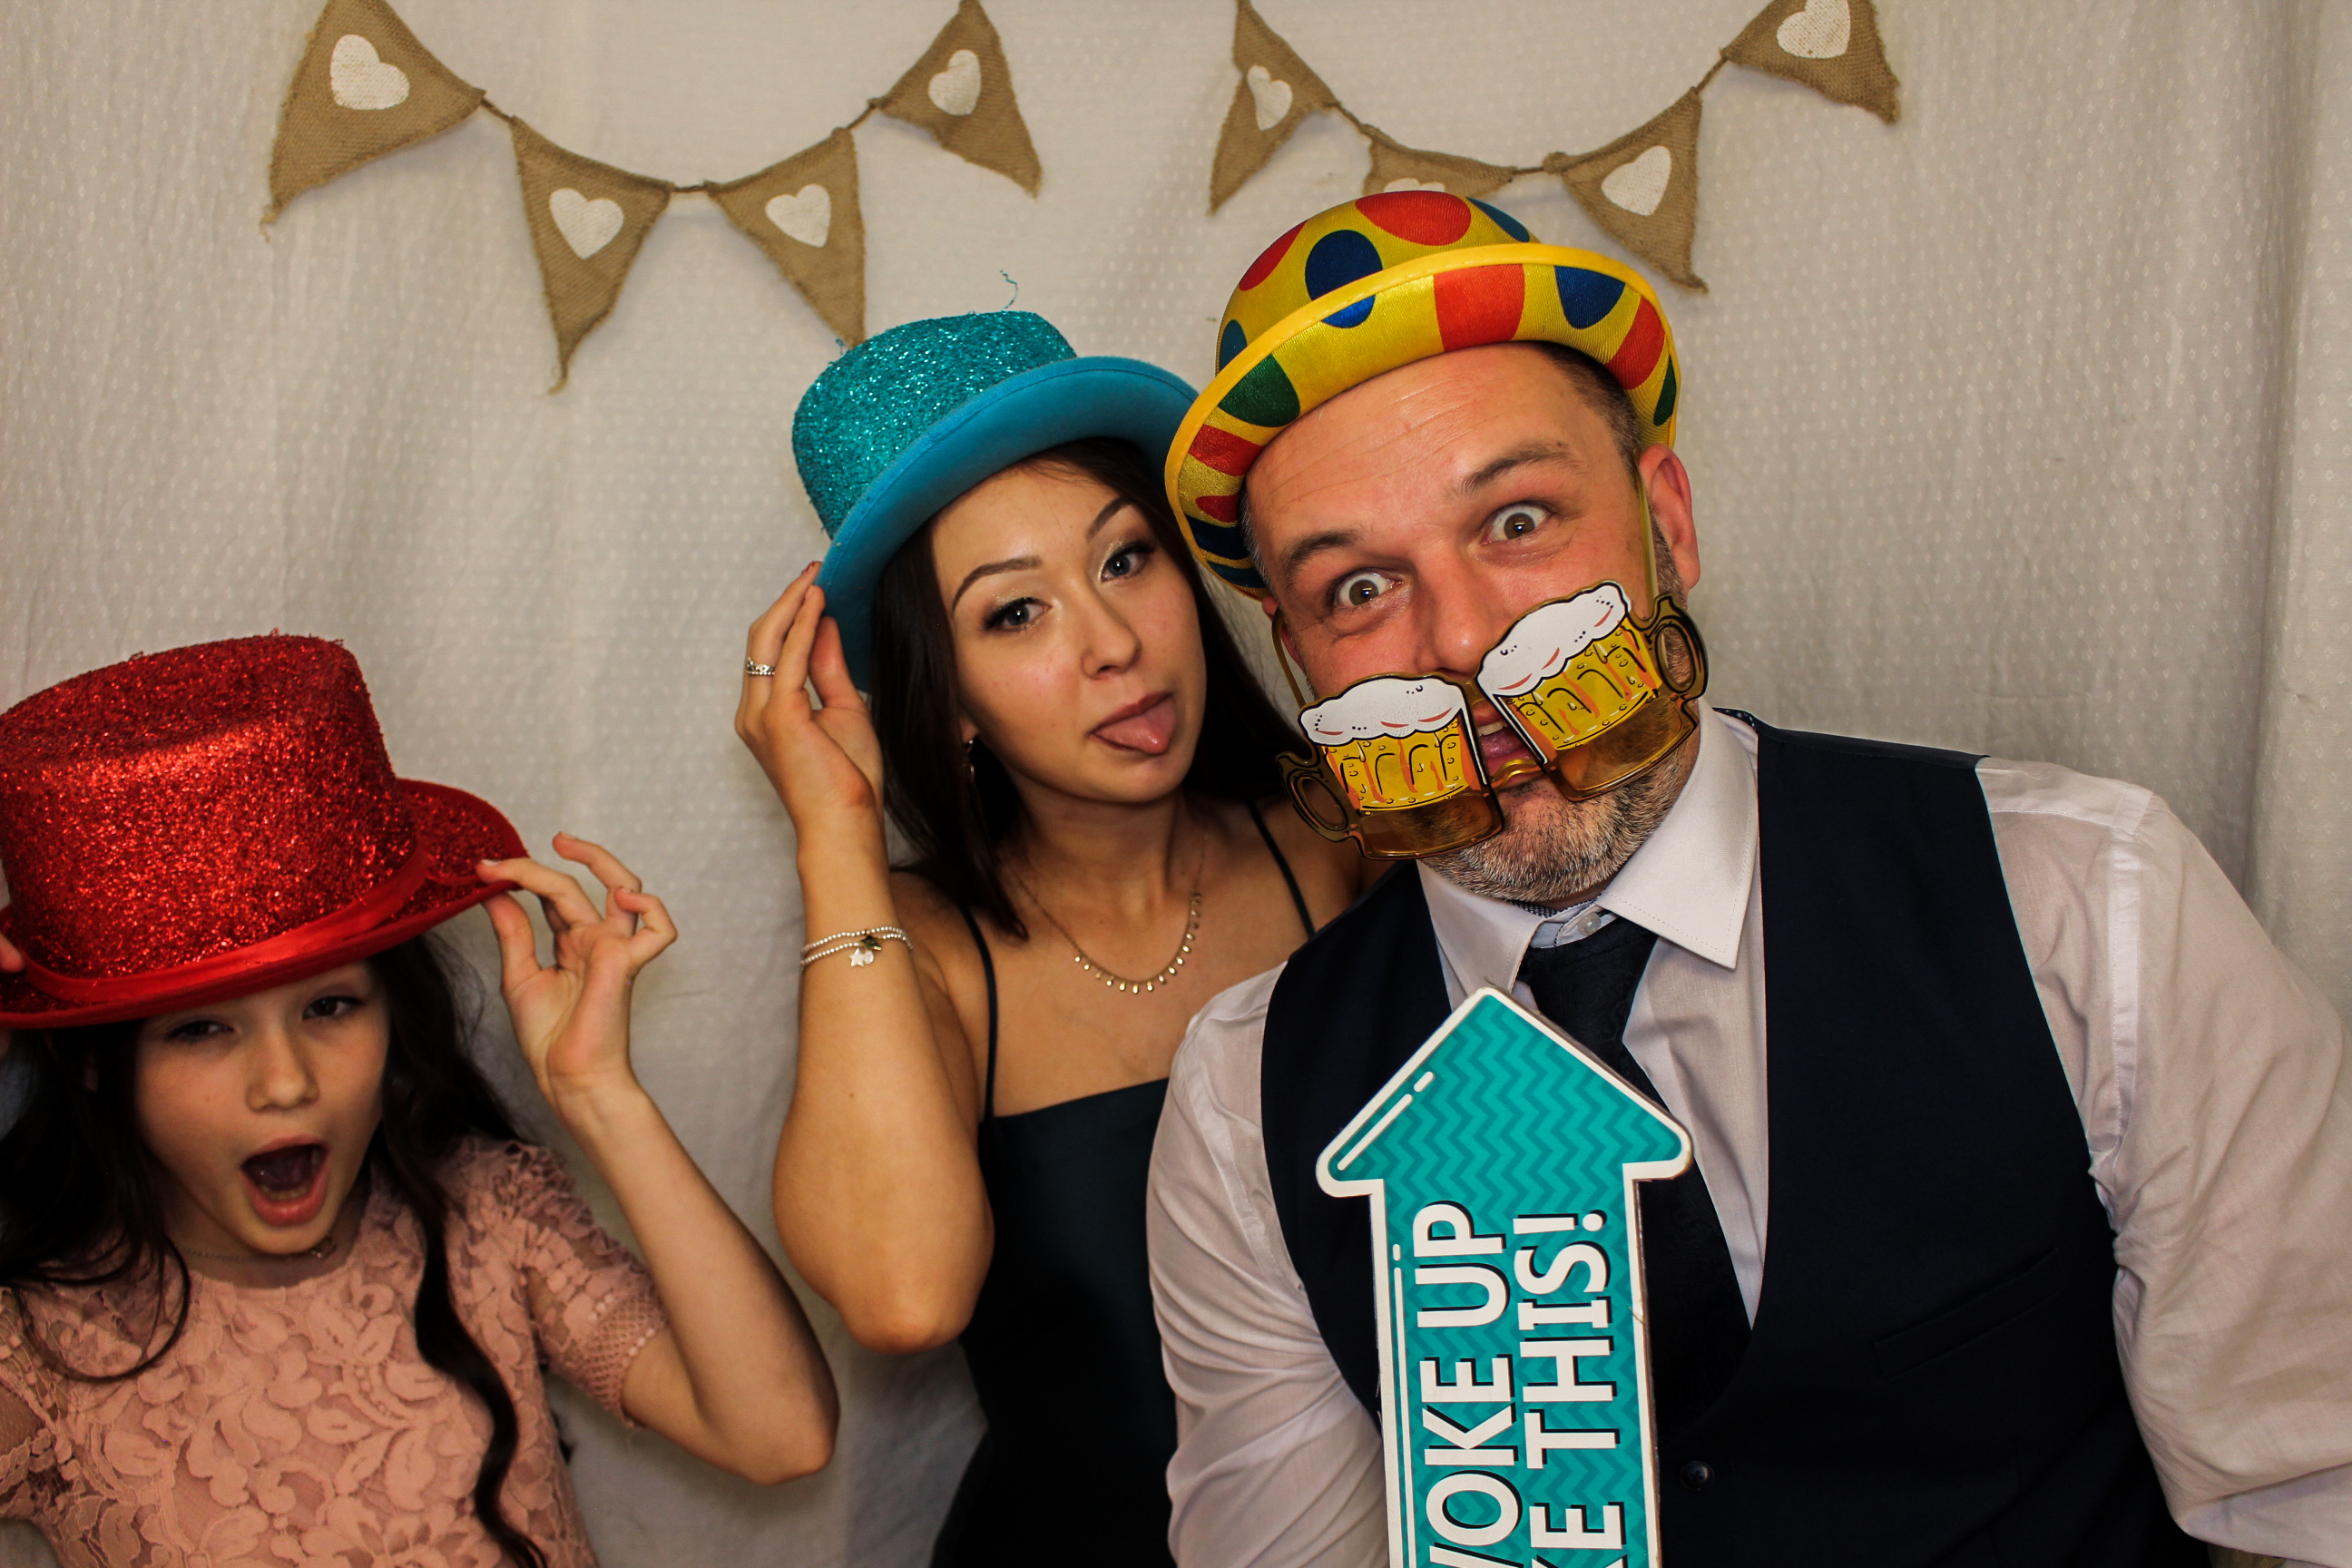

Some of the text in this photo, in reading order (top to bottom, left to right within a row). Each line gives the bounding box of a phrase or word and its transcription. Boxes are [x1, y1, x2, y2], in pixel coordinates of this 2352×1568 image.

[1412, 1200, 1510, 1328] UP
[1513, 1210, 1627, 1568] E THIS!
